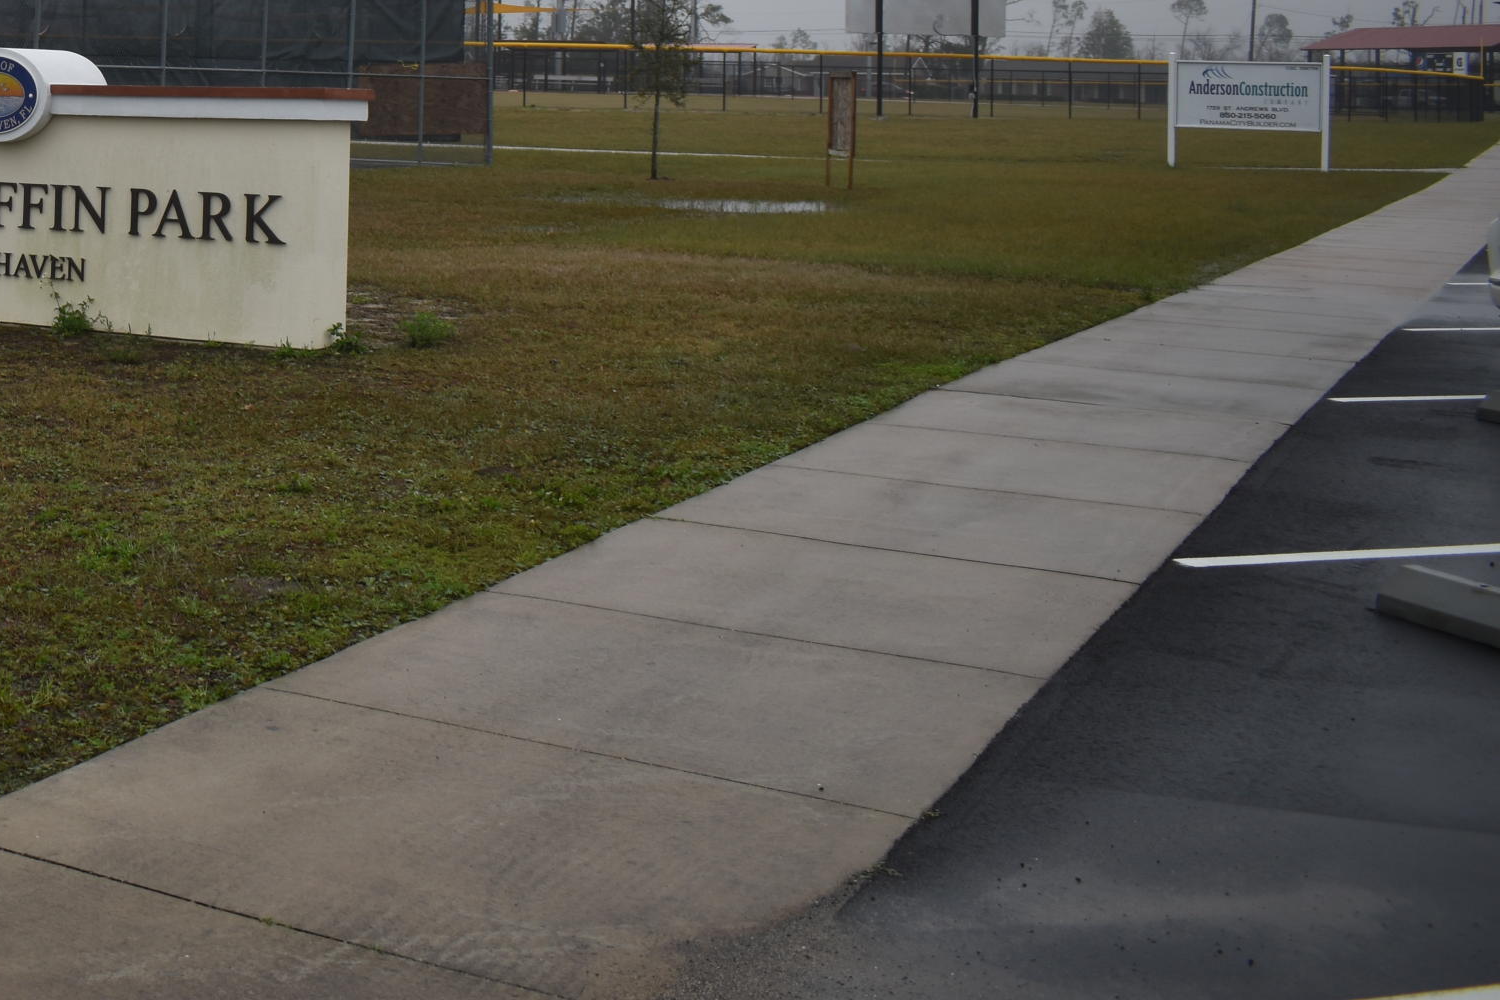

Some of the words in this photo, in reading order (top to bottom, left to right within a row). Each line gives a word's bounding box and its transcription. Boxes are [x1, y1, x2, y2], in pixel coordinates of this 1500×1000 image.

[0, 60, 15, 72] OF
[1189, 79, 1308, 97] AndersonConstruction
[19, 105, 33, 120] FL
[1219, 112, 1277, 120] 850-215-5060
[128, 187, 287, 245] PARK
